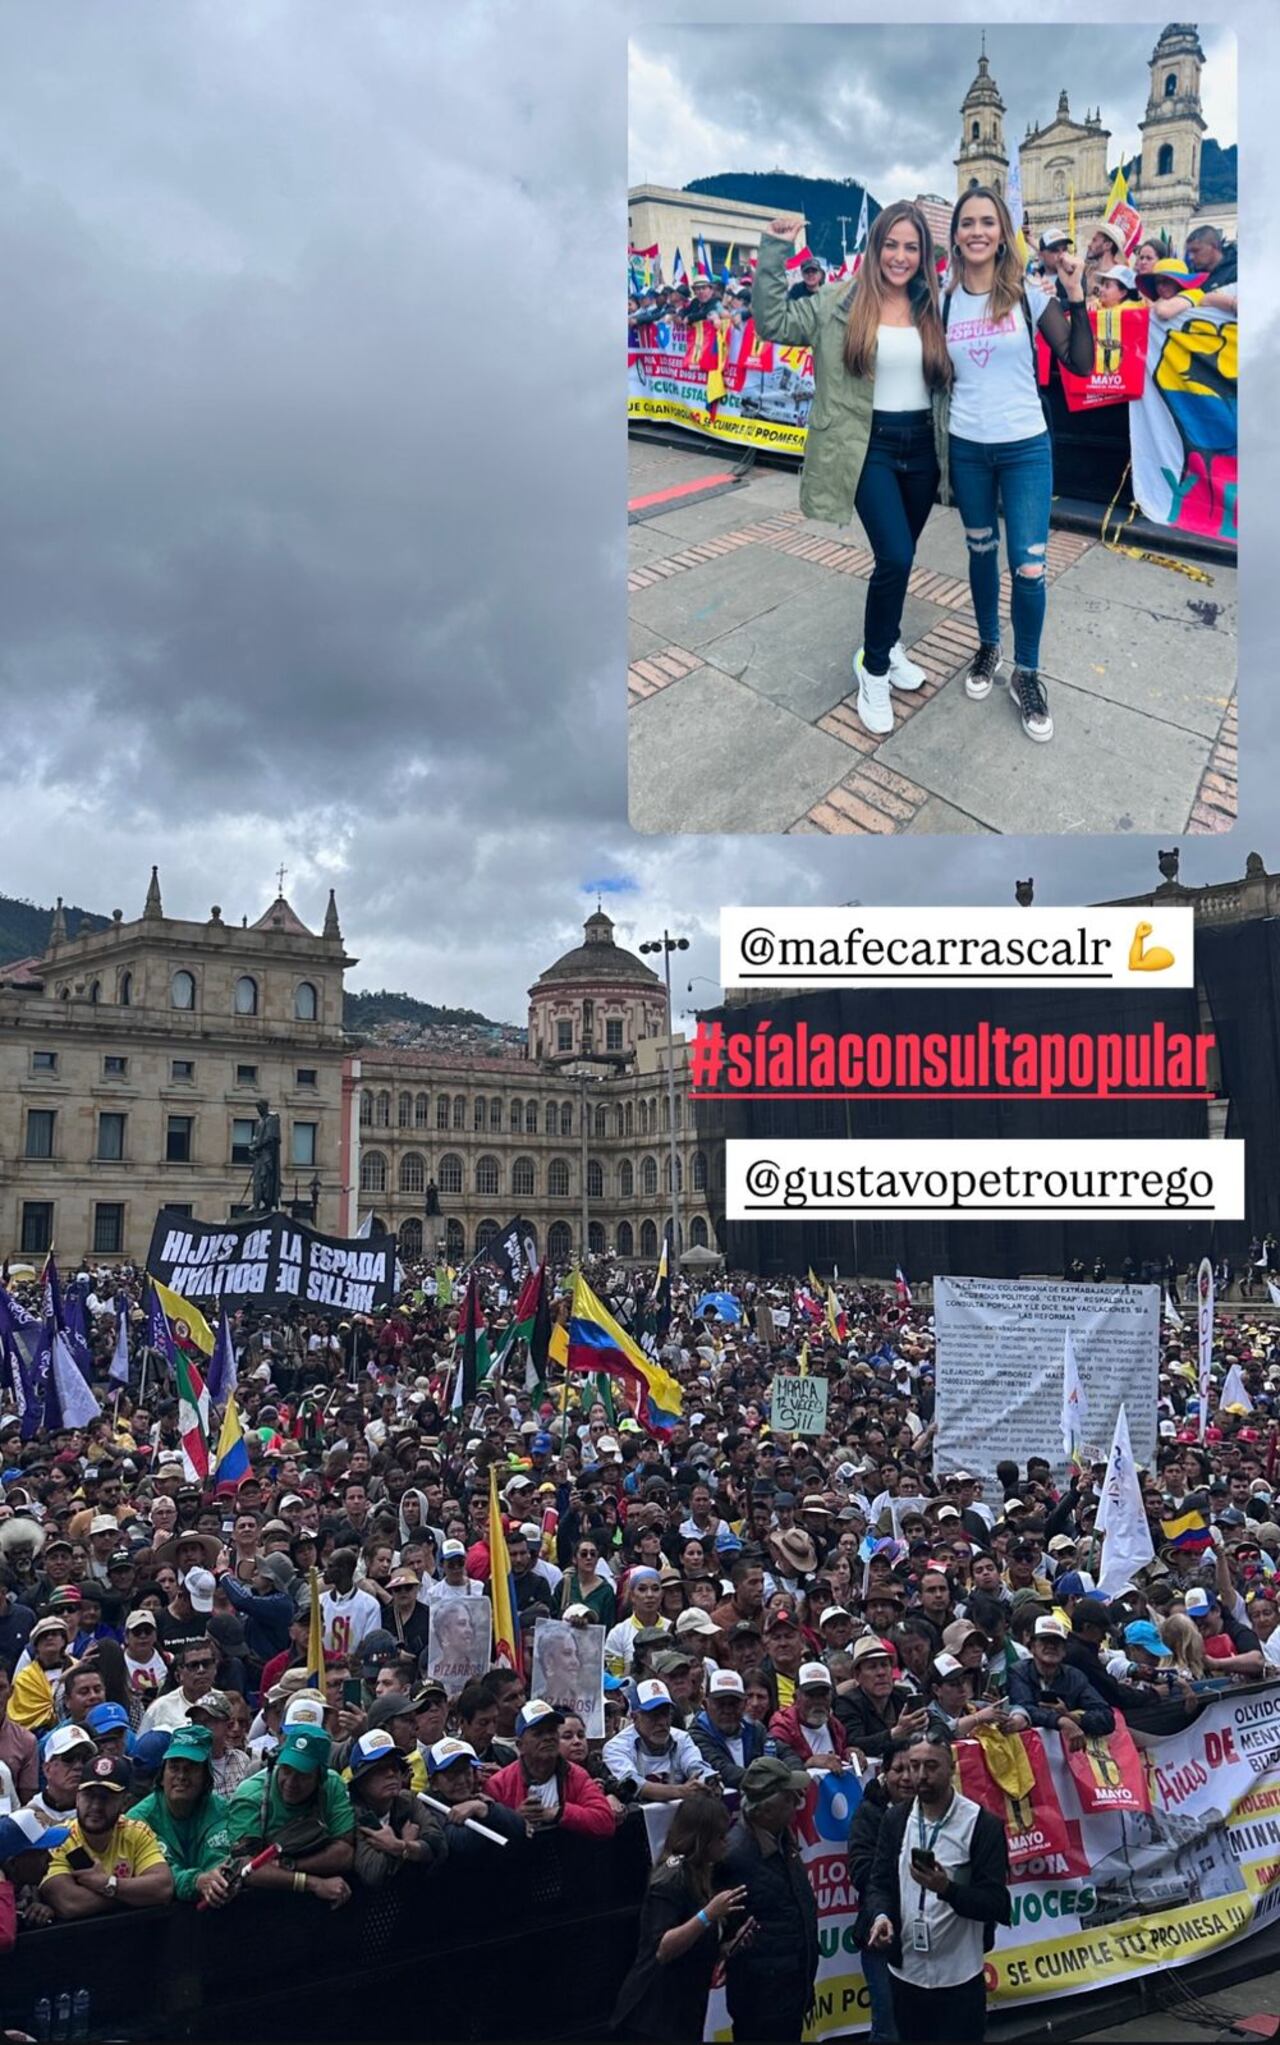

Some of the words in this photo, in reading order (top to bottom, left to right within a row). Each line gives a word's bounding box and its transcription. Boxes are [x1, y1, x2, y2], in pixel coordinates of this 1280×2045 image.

[241, 1228, 273, 1261] DE
[279, 1230, 303, 1264] LA
[309, 1241, 387, 1283] ESPADA
[275, 1262, 302, 1296] DE
[962, 1282, 996, 1291] CENTRAL
[998, 1284, 1047, 1293] COLOMBIANA
[945, 1299, 985, 1308] CONSULTA
[987, 1301, 1022, 1310] POPULAR
[1034, 1313, 1076, 1321] REFORMAS
[1203, 1726, 1241, 1769] DE
[1094, 1787, 1133, 1800] MAYO
[1008, 1831, 1044, 1851] MAYO
[1006, 1960, 1032, 1987] SE
[1034, 1940, 1109, 1979] CUMPLE
[1114, 1932, 1147, 1958] TU
[1149, 1913, 1229, 1951] PROMESA
